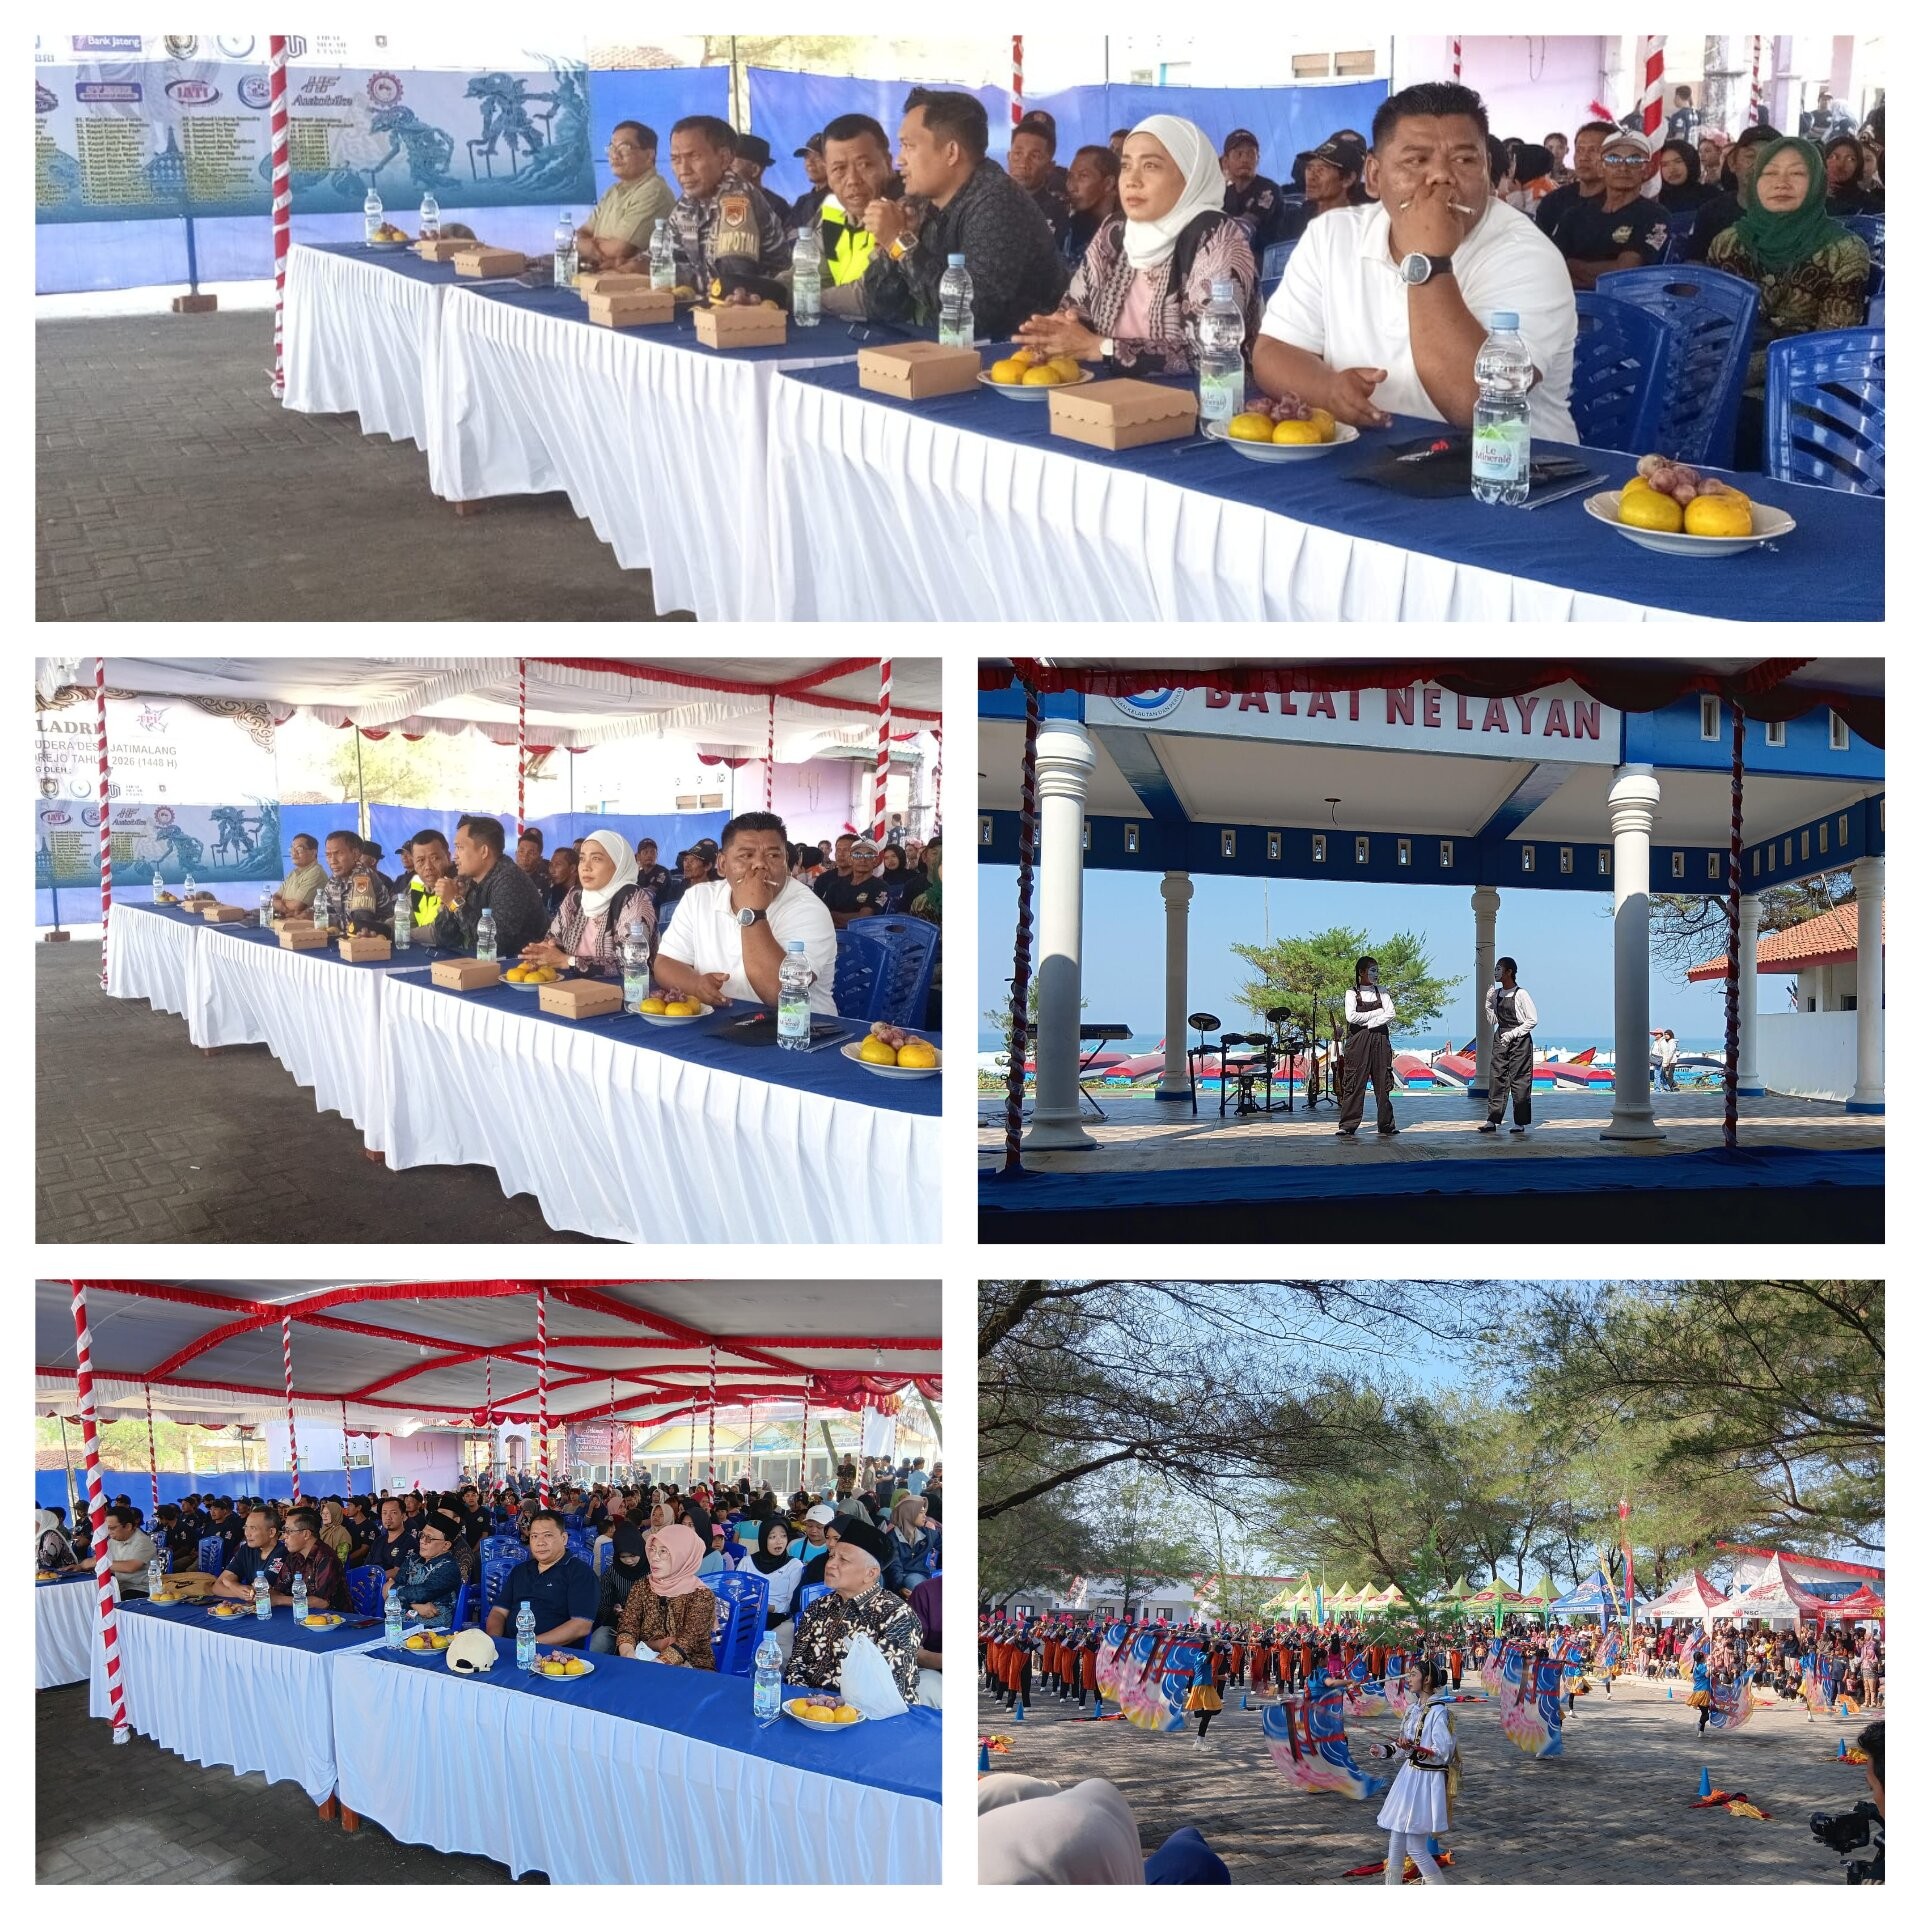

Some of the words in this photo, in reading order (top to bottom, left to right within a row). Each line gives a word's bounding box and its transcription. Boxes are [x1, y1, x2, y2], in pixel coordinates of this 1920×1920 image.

[88, 35, 111, 46] Bank
[1127, 707, 1158, 717] KELAUTAN
[1159, 706, 1170, 716] DAN
[77, 742, 99, 752] DES
[110, 743, 177, 755] JATIMALANG
[72, 754, 100, 765] TAHU
[112, 756, 135, 766] 2026
[167, 758, 178, 769] H)
[44, 766, 67, 774] OLEH
